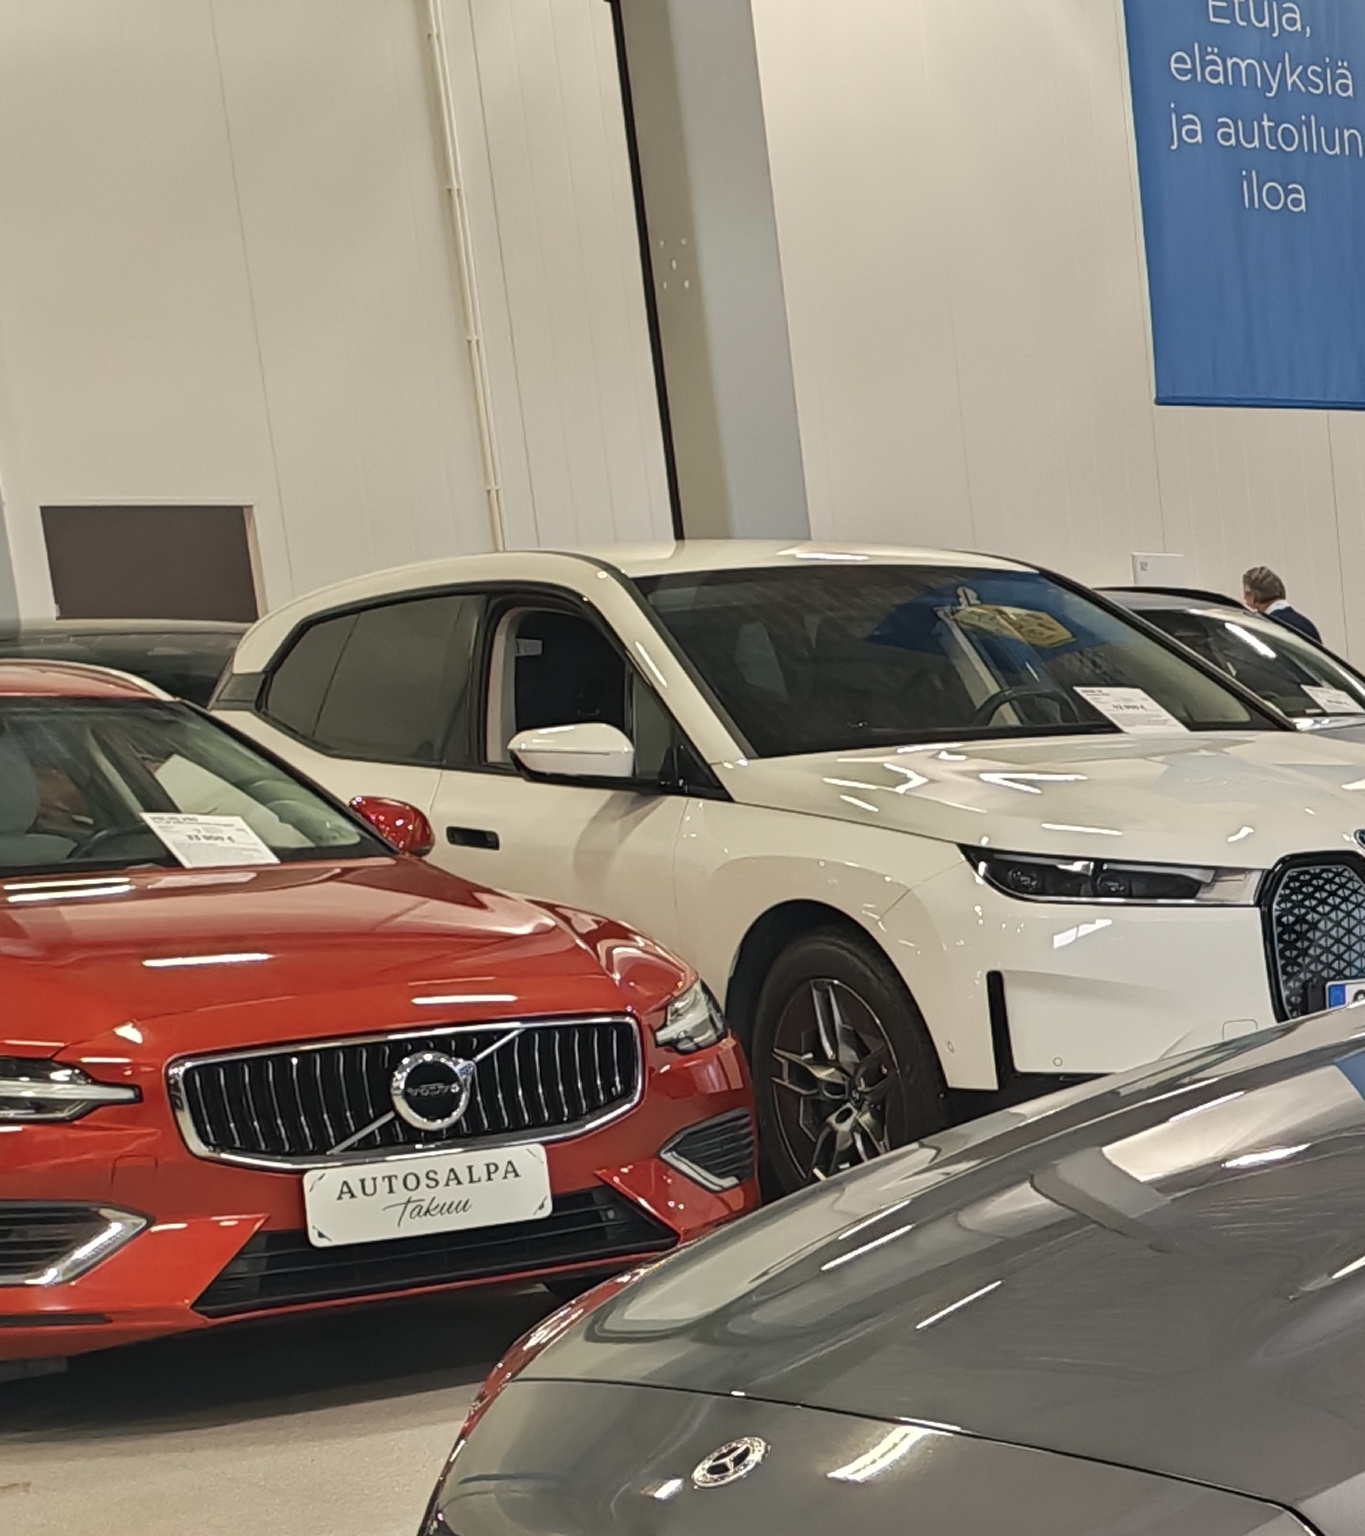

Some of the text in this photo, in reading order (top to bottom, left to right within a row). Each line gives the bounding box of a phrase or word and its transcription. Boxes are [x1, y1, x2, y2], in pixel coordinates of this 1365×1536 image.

[1207, 0, 1312, 38] Etuja,
[1169, 41, 1354, 98] elämyksiä
[1170, 101, 1364, 158] ja autoilun
[1241, 168, 1307, 213] iloa
[335, 1158, 522, 1201] AUTOSALPA
[382, 1195, 473, 1228] Takuu
